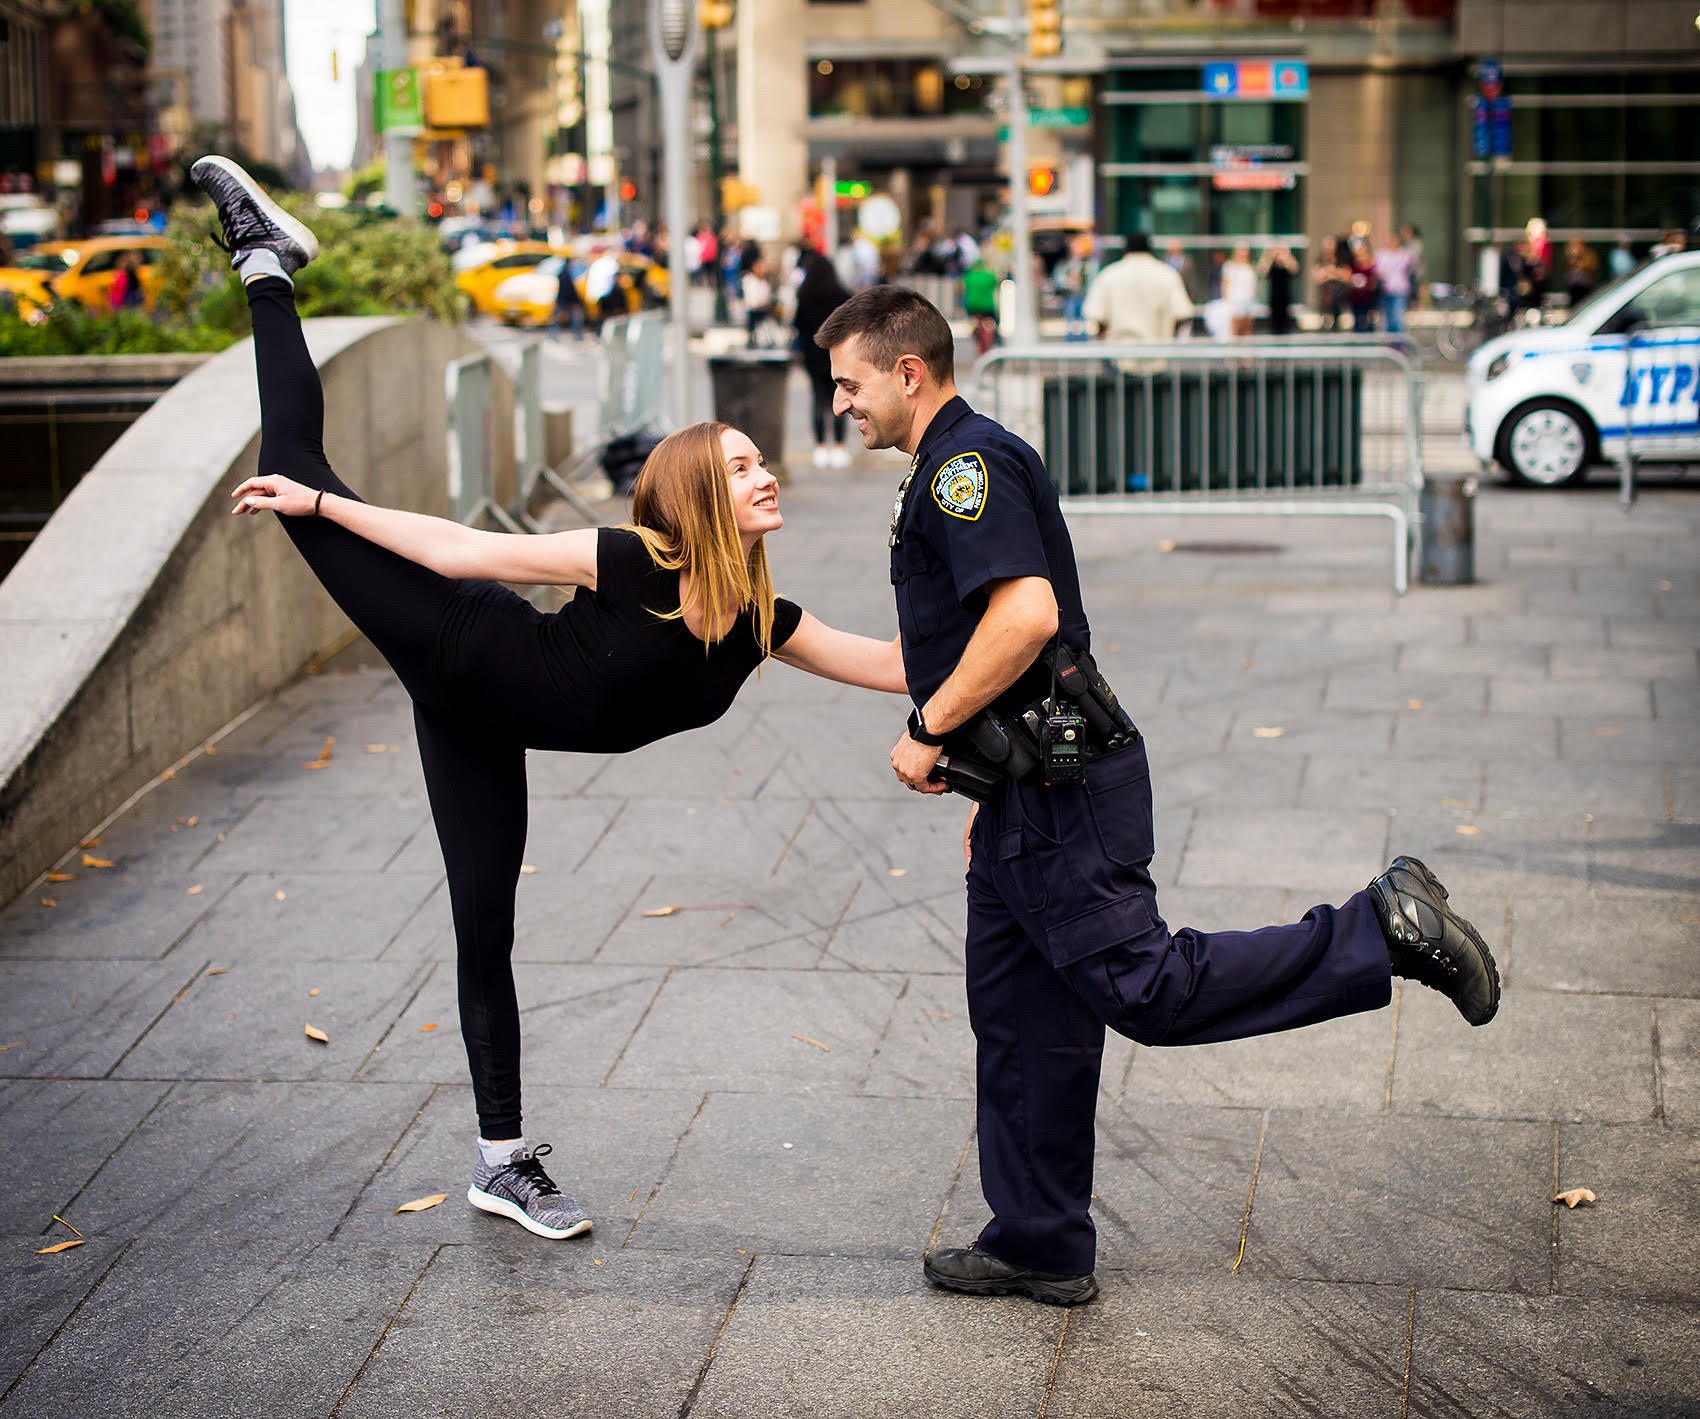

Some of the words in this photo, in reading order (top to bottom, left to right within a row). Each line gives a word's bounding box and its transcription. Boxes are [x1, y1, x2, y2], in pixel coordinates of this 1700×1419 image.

[940, 458, 964, 479] POLICE
[941, 499, 954, 510] CITY
[974, 492, 983, 509] NEW
